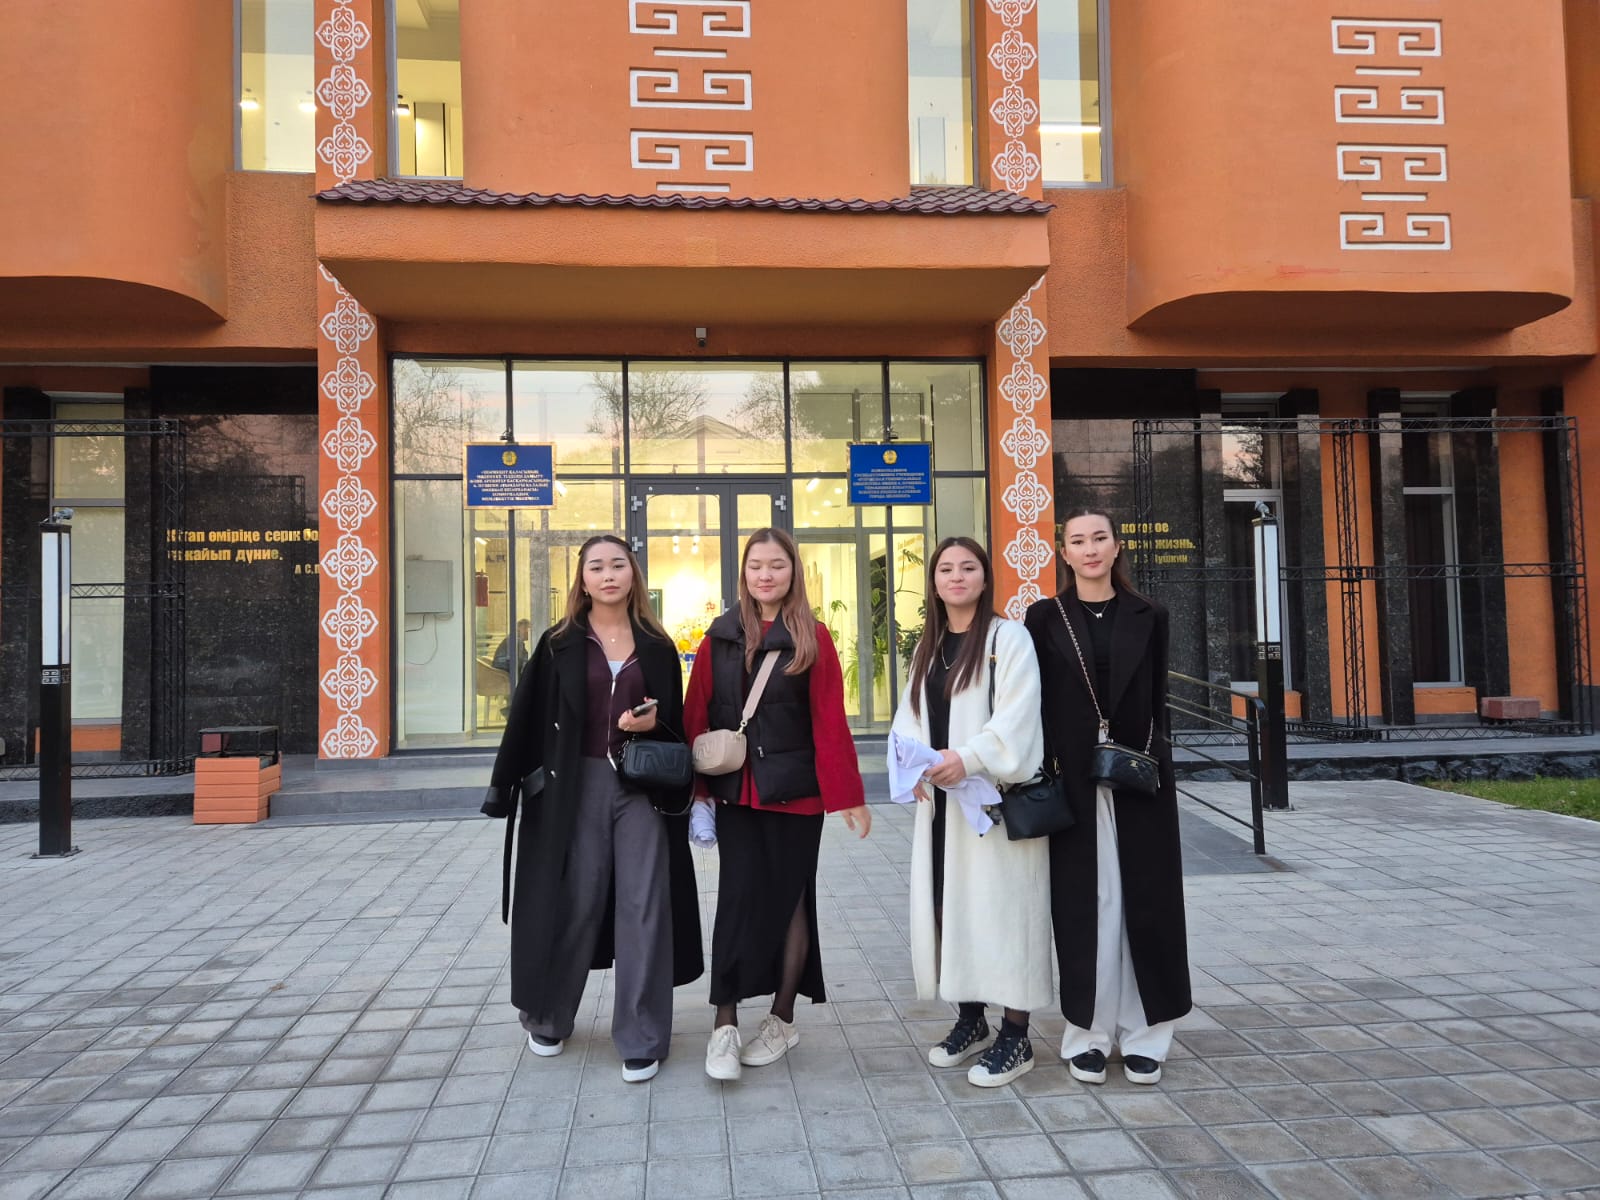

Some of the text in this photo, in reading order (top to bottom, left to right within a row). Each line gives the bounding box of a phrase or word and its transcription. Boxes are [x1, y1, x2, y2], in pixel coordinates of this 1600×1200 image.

[208, 529, 261, 543] өміріңе
[265, 530, 301, 543] серік
[235, 549, 283, 564] дүние.
